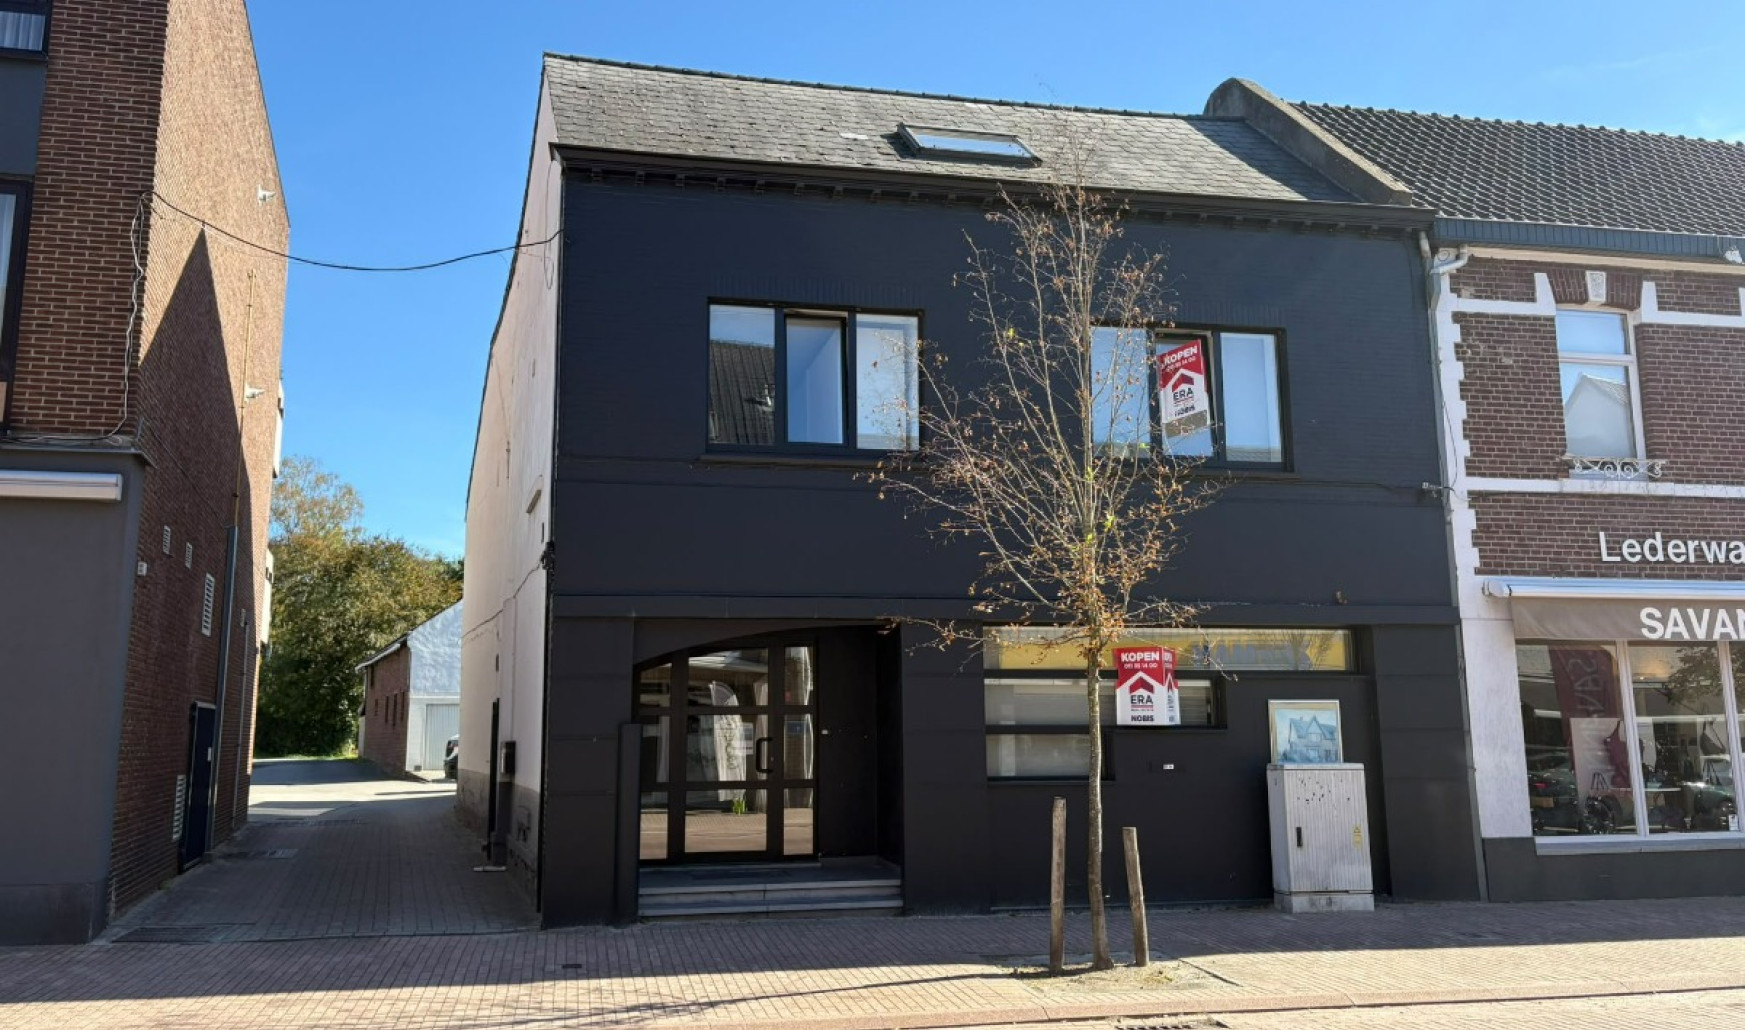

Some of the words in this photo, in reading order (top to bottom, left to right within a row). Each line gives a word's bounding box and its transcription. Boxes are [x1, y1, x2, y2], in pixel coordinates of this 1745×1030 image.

[1164, 345, 1198, 365] KOPEN
[1173, 387, 1194, 401] ERA
[1599, 531, 1745, 564] Lederwa
[1120, 651, 1160, 662] KOPEN
[1131, 695, 1153, 704] ERA
